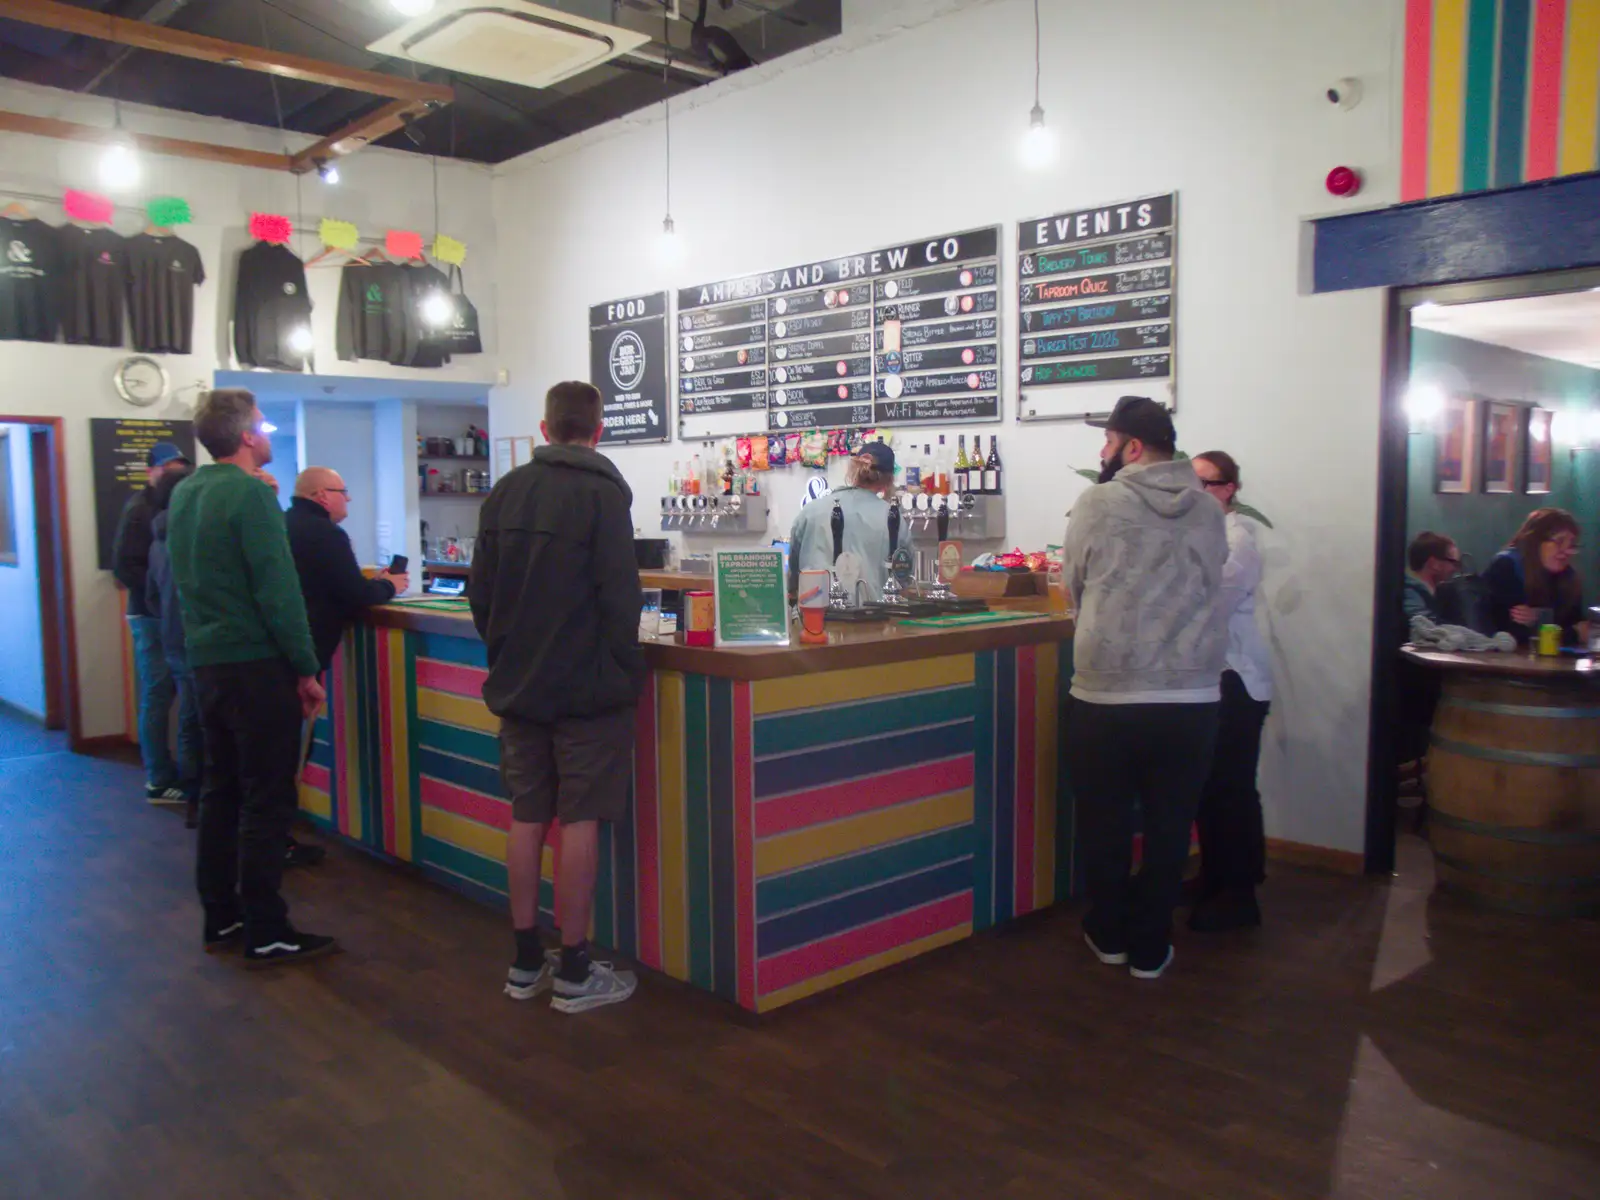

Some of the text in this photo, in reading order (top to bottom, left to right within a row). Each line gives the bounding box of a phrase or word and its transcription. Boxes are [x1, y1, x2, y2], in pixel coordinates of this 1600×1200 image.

[1036, 203, 1152, 244] EVENTS
[700, 265, 824, 304] AMPERSAND
[839, 248, 909, 278] BREW
[925, 238, 959, 262] CO
[608, 300, 645, 321] FOOD
[602, 413, 647, 427] RDER HERE
